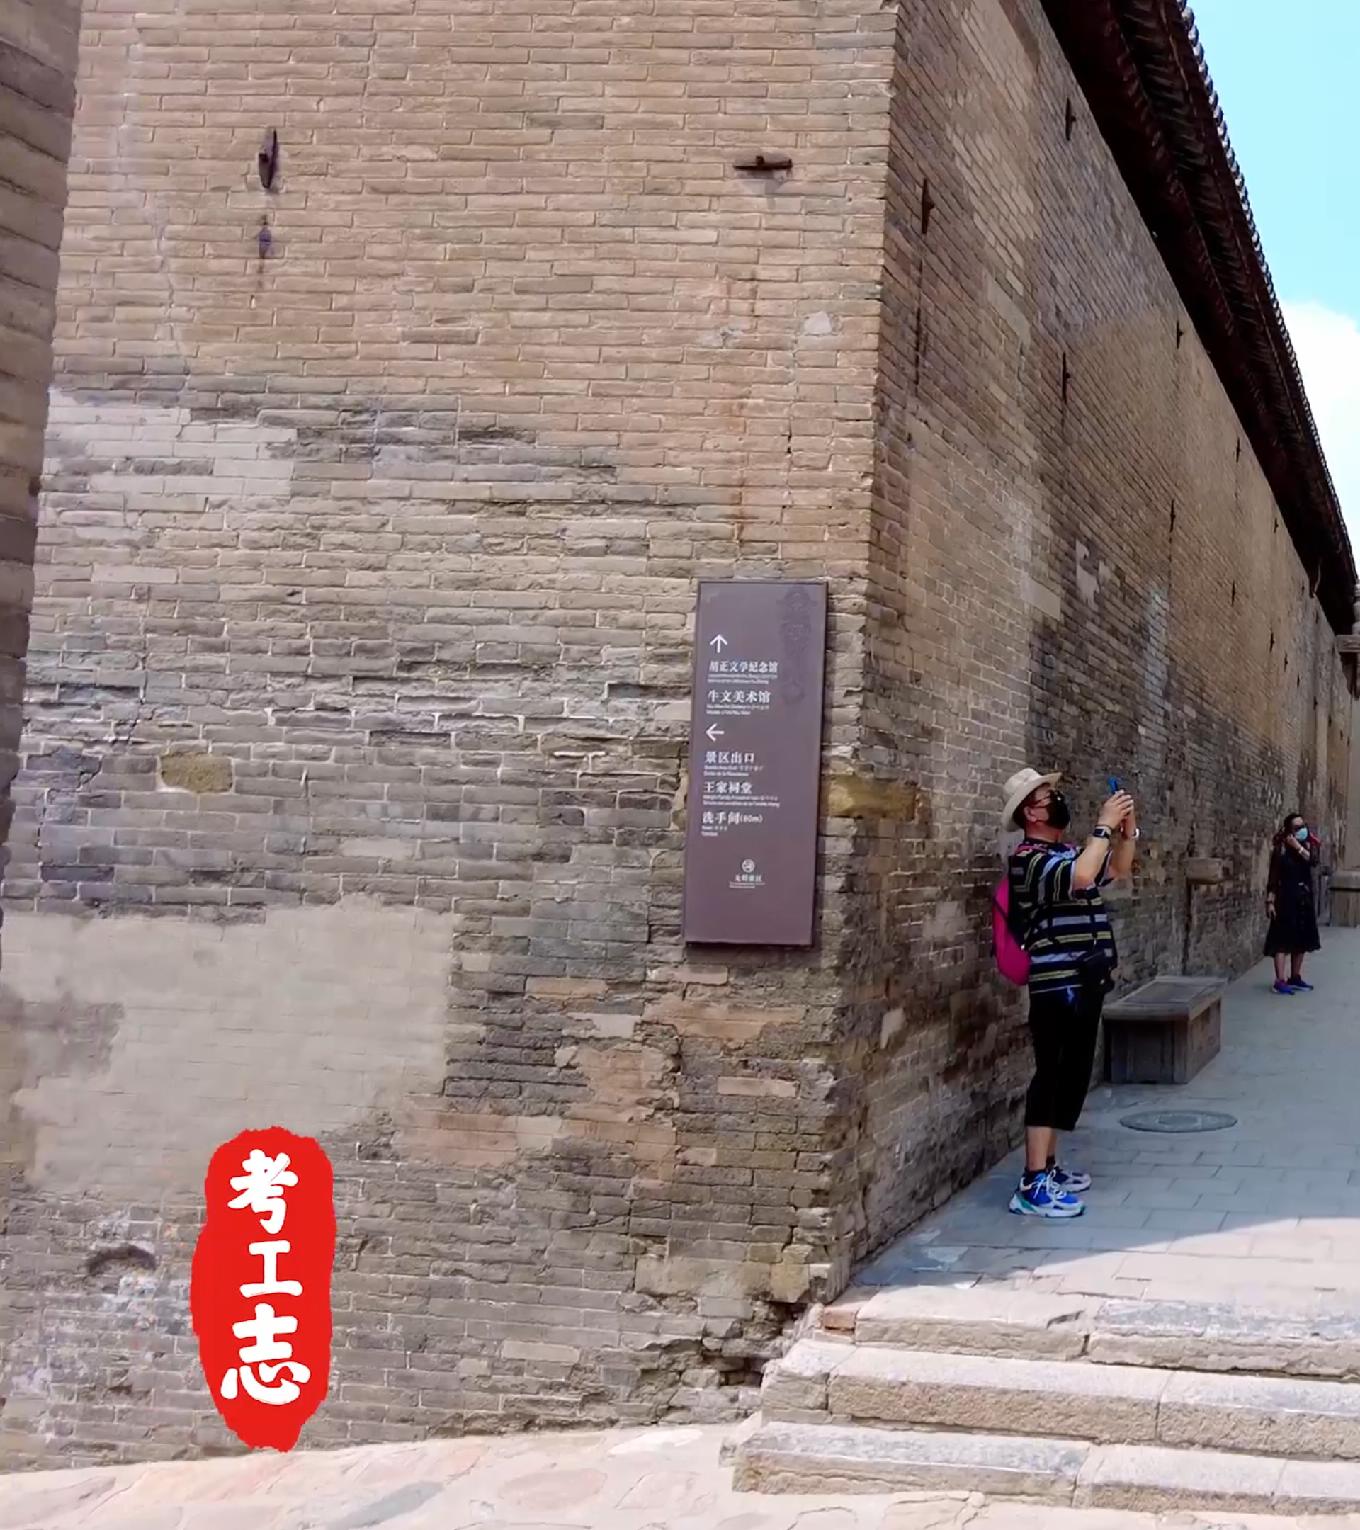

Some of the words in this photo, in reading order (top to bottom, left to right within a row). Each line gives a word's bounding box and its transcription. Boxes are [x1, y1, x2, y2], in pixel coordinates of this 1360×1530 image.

[707, 689, 771, 704] 牛文美术馆
[704, 751, 755, 764] 景区出口
[703, 781, 753, 794] 王家祠堂
